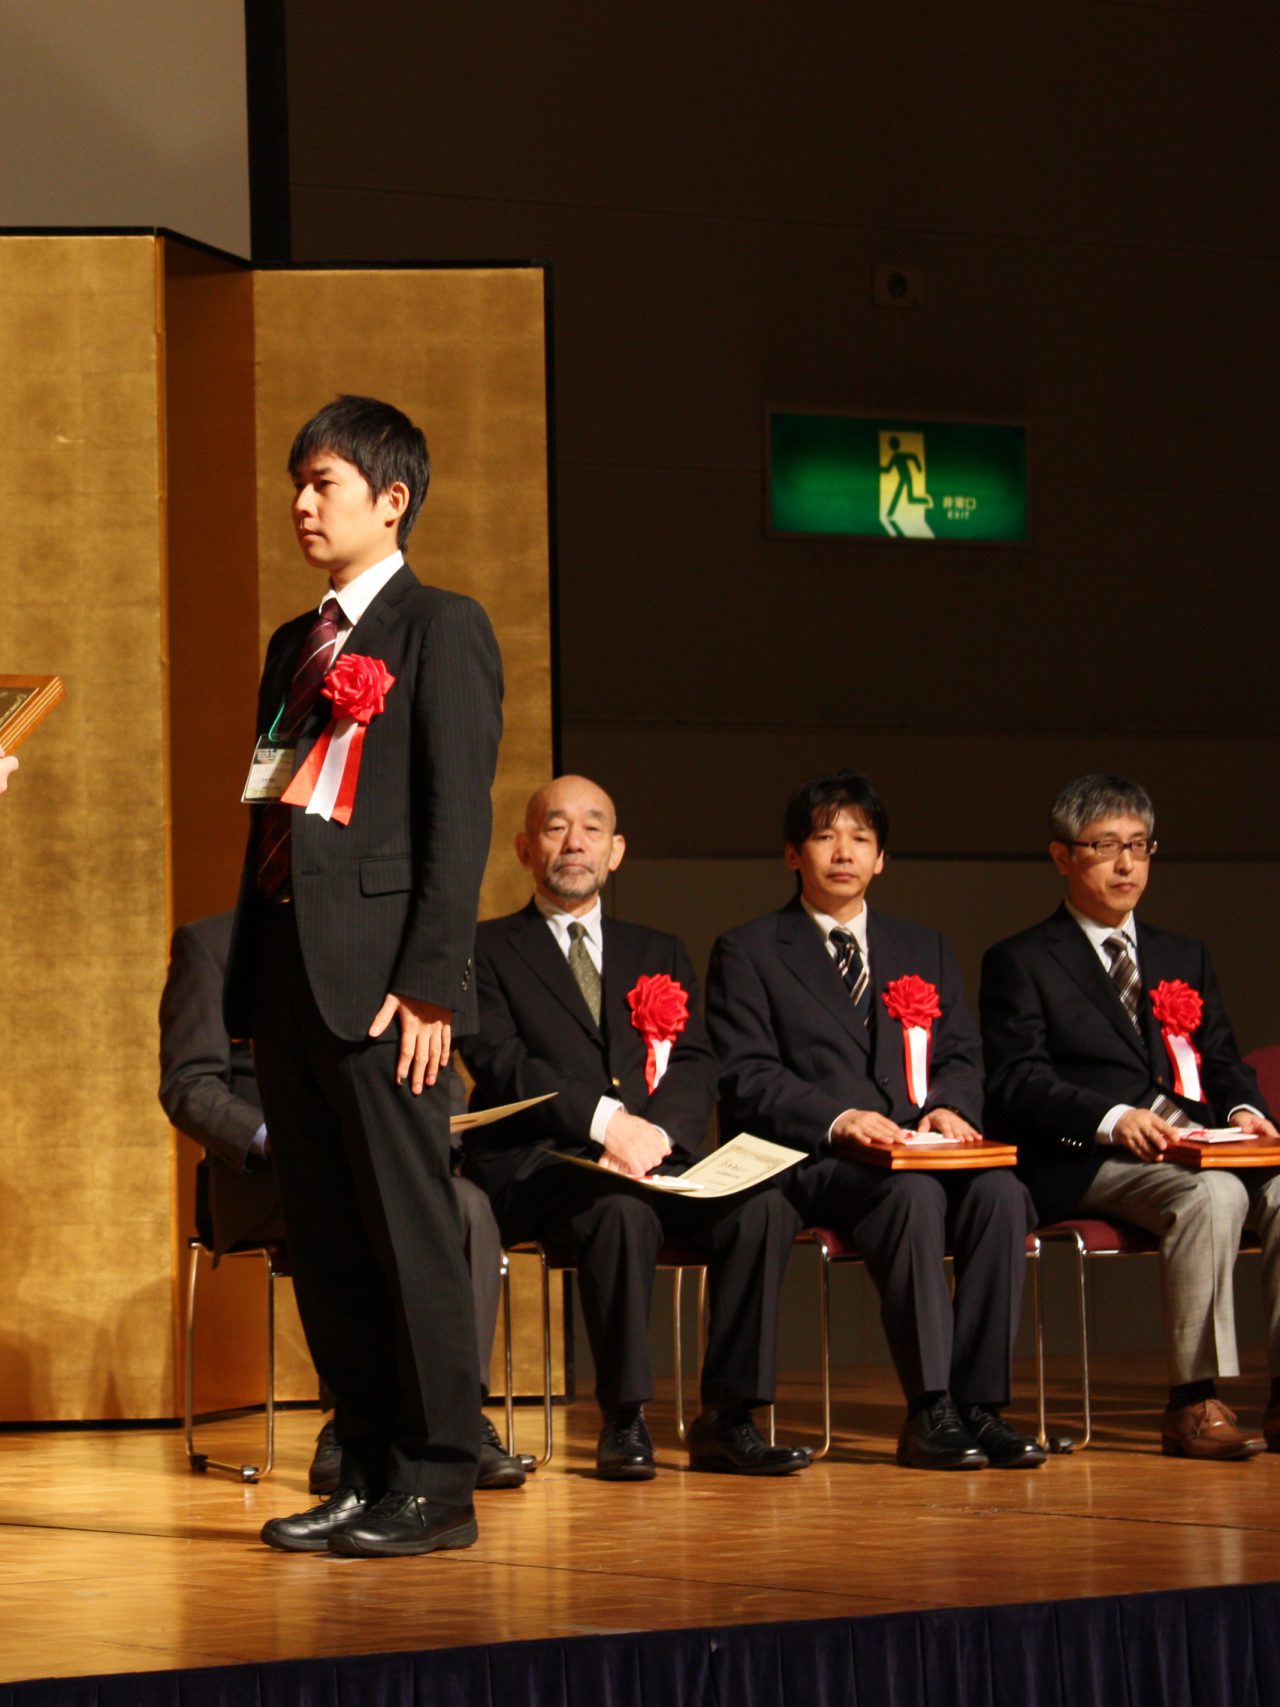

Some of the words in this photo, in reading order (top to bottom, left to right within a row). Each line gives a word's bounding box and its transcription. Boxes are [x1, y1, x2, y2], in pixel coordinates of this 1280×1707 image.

[943, 496, 977, 510] 非常口
[948, 511, 970, 520] EXIT
